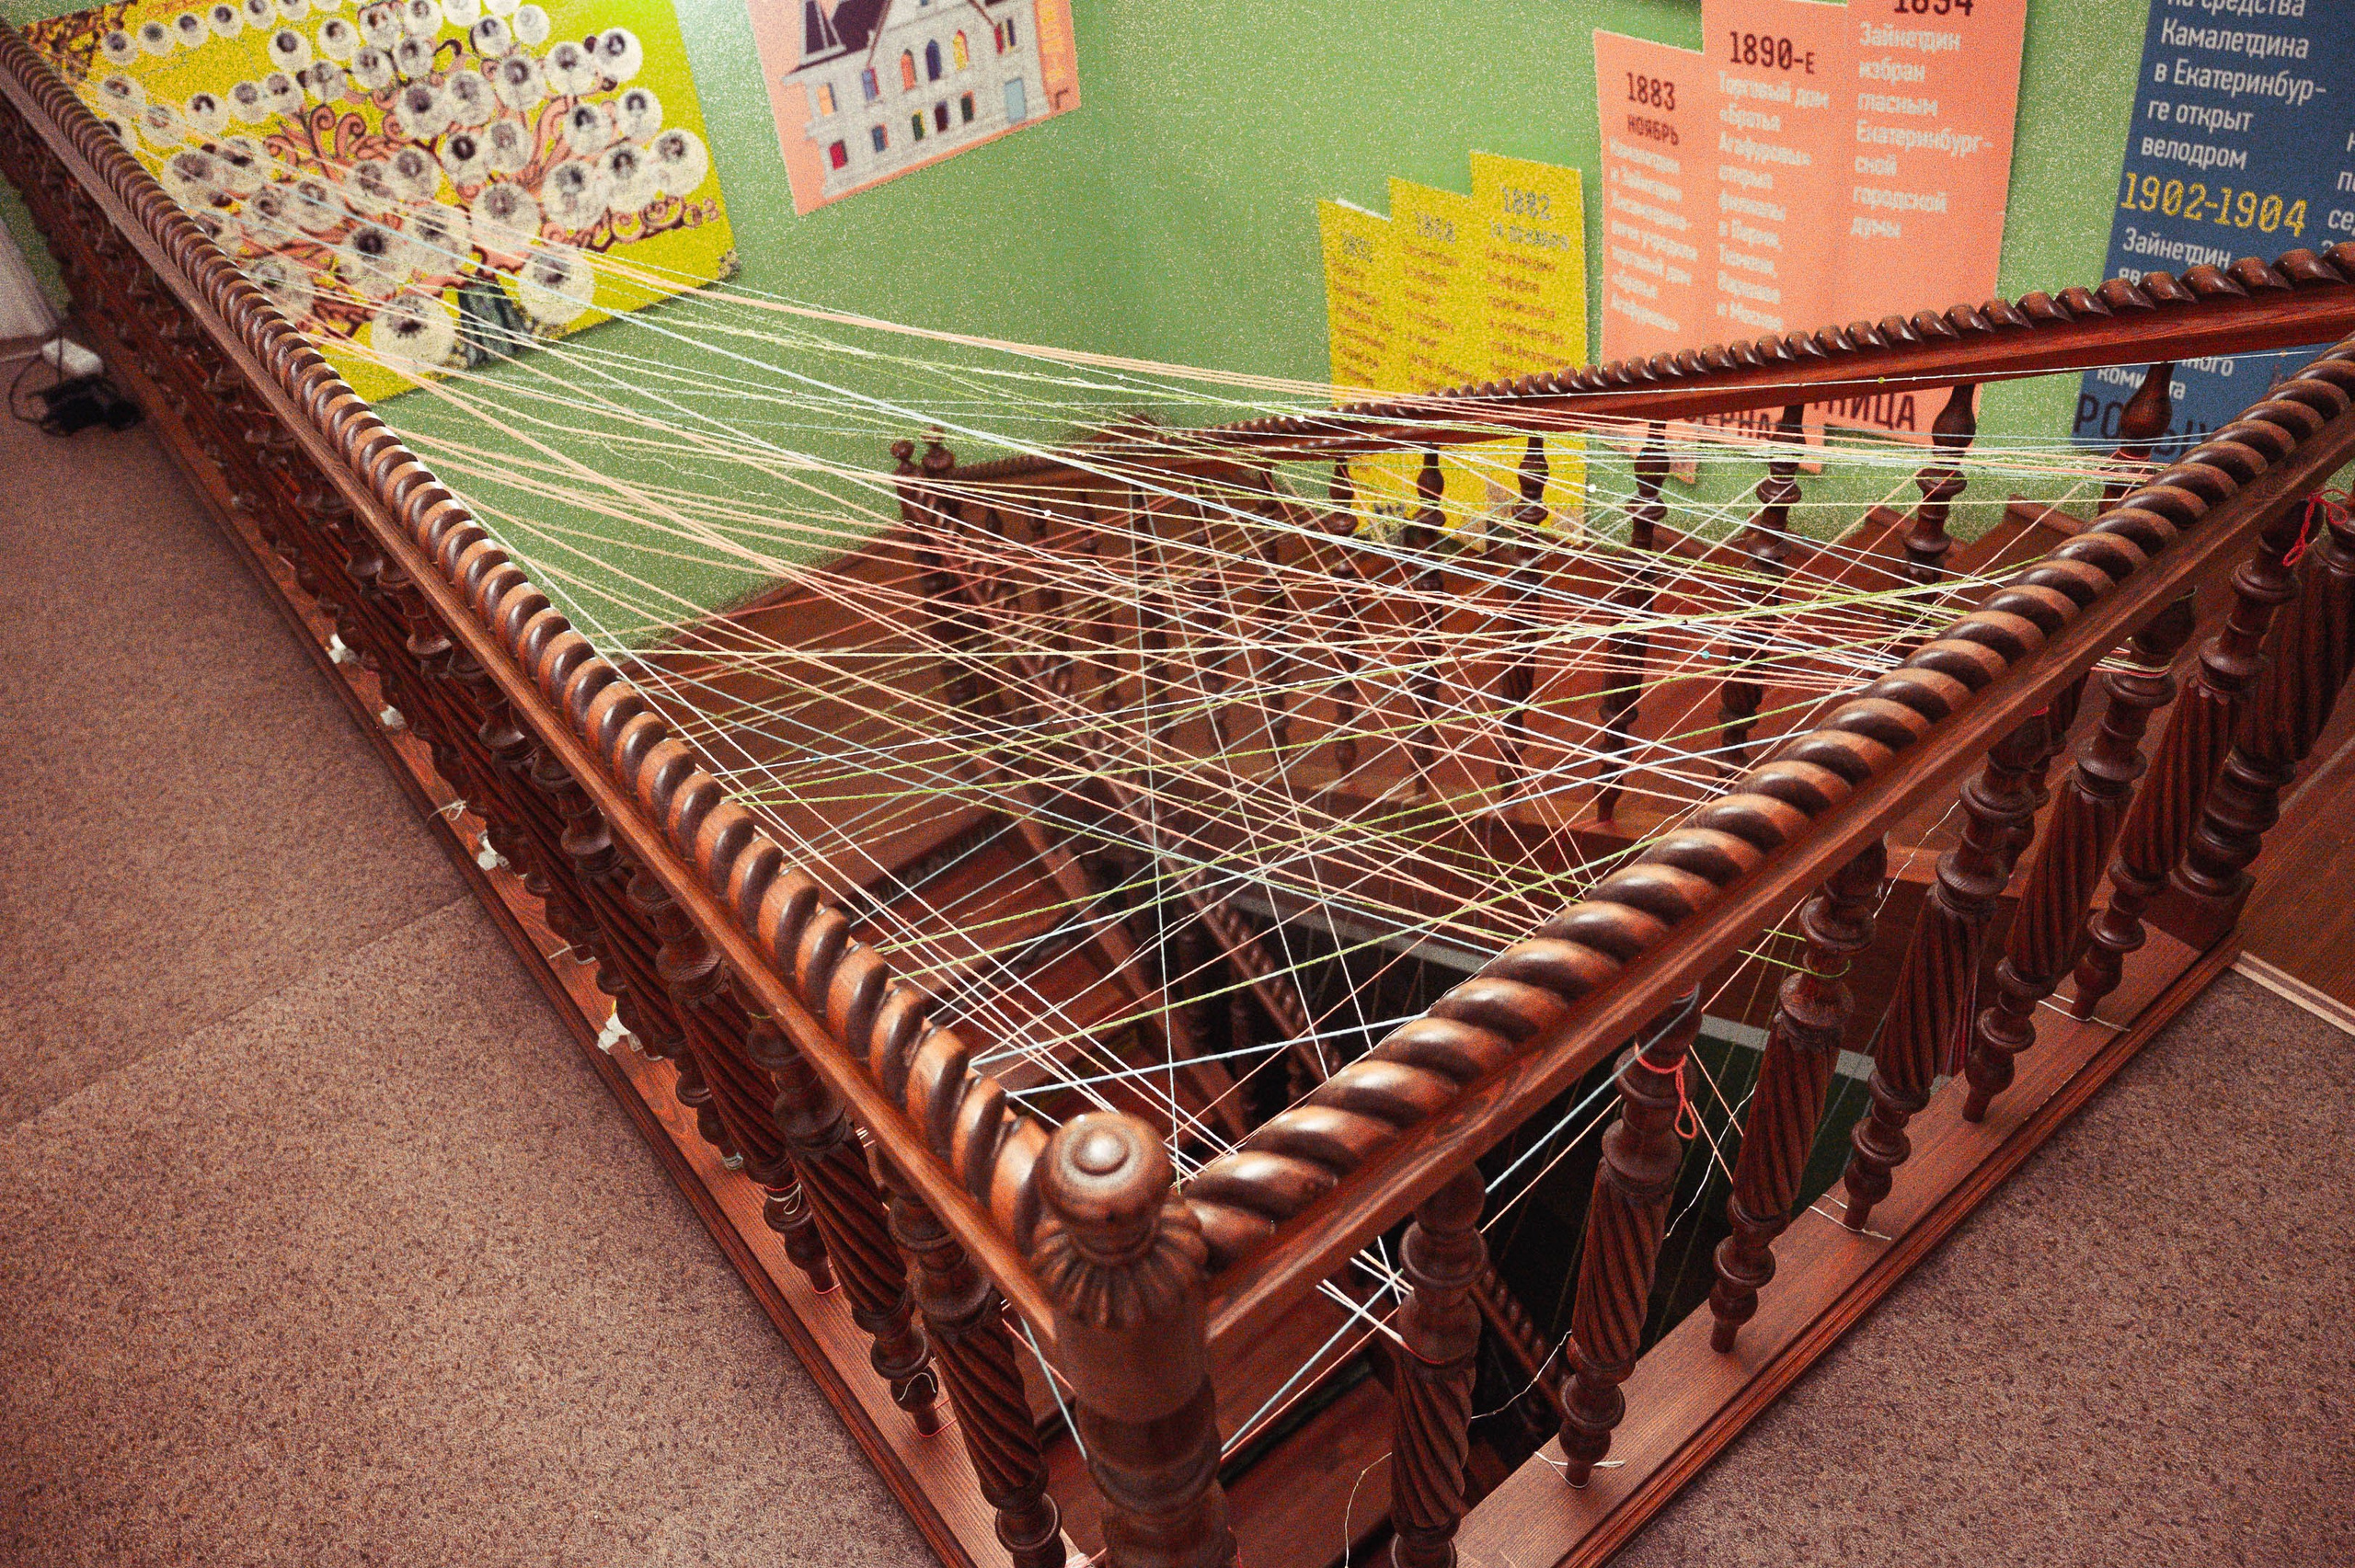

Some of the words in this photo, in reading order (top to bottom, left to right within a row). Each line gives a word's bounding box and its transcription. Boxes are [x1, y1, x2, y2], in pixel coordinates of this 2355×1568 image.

[1730, 31, 1815, 74] 1890-Е
[1859, 21, 1960, 52] Зайнетдин
[2161, 17, 2309, 59] Камалетдина
[1859, 57, 1925, 86] избран
[2154, 63, 2167, 82] в
[2174, 58, 2326, 106] Екатеринбур-
[1626, 72, 1675, 111] 1883
[1718, 70, 1791, 103] Торговый
[1795, 88, 1830, 109] дом
[1857, 93, 1938, 117] гласным
[1627, 114, 1680, 145] НОЯБРЬ
[2147, 100, 2170, 121] ге
[2176, 103, 2253, 133] открыт
[1856, 120, 1993, 157] Екатеринбург-
[2141, 137, 2247, 170] велодром
[1855, 154, 1897, 176] ской
[1501, 186, 1551, 221] 1882
[1853, 186, 1947, 213] городской
[2120, 172, 2307, 236] 1902-1904
[1850, 216, 1902, 239] думы
[2122, 227, 2231, 270] Зайнетдин
